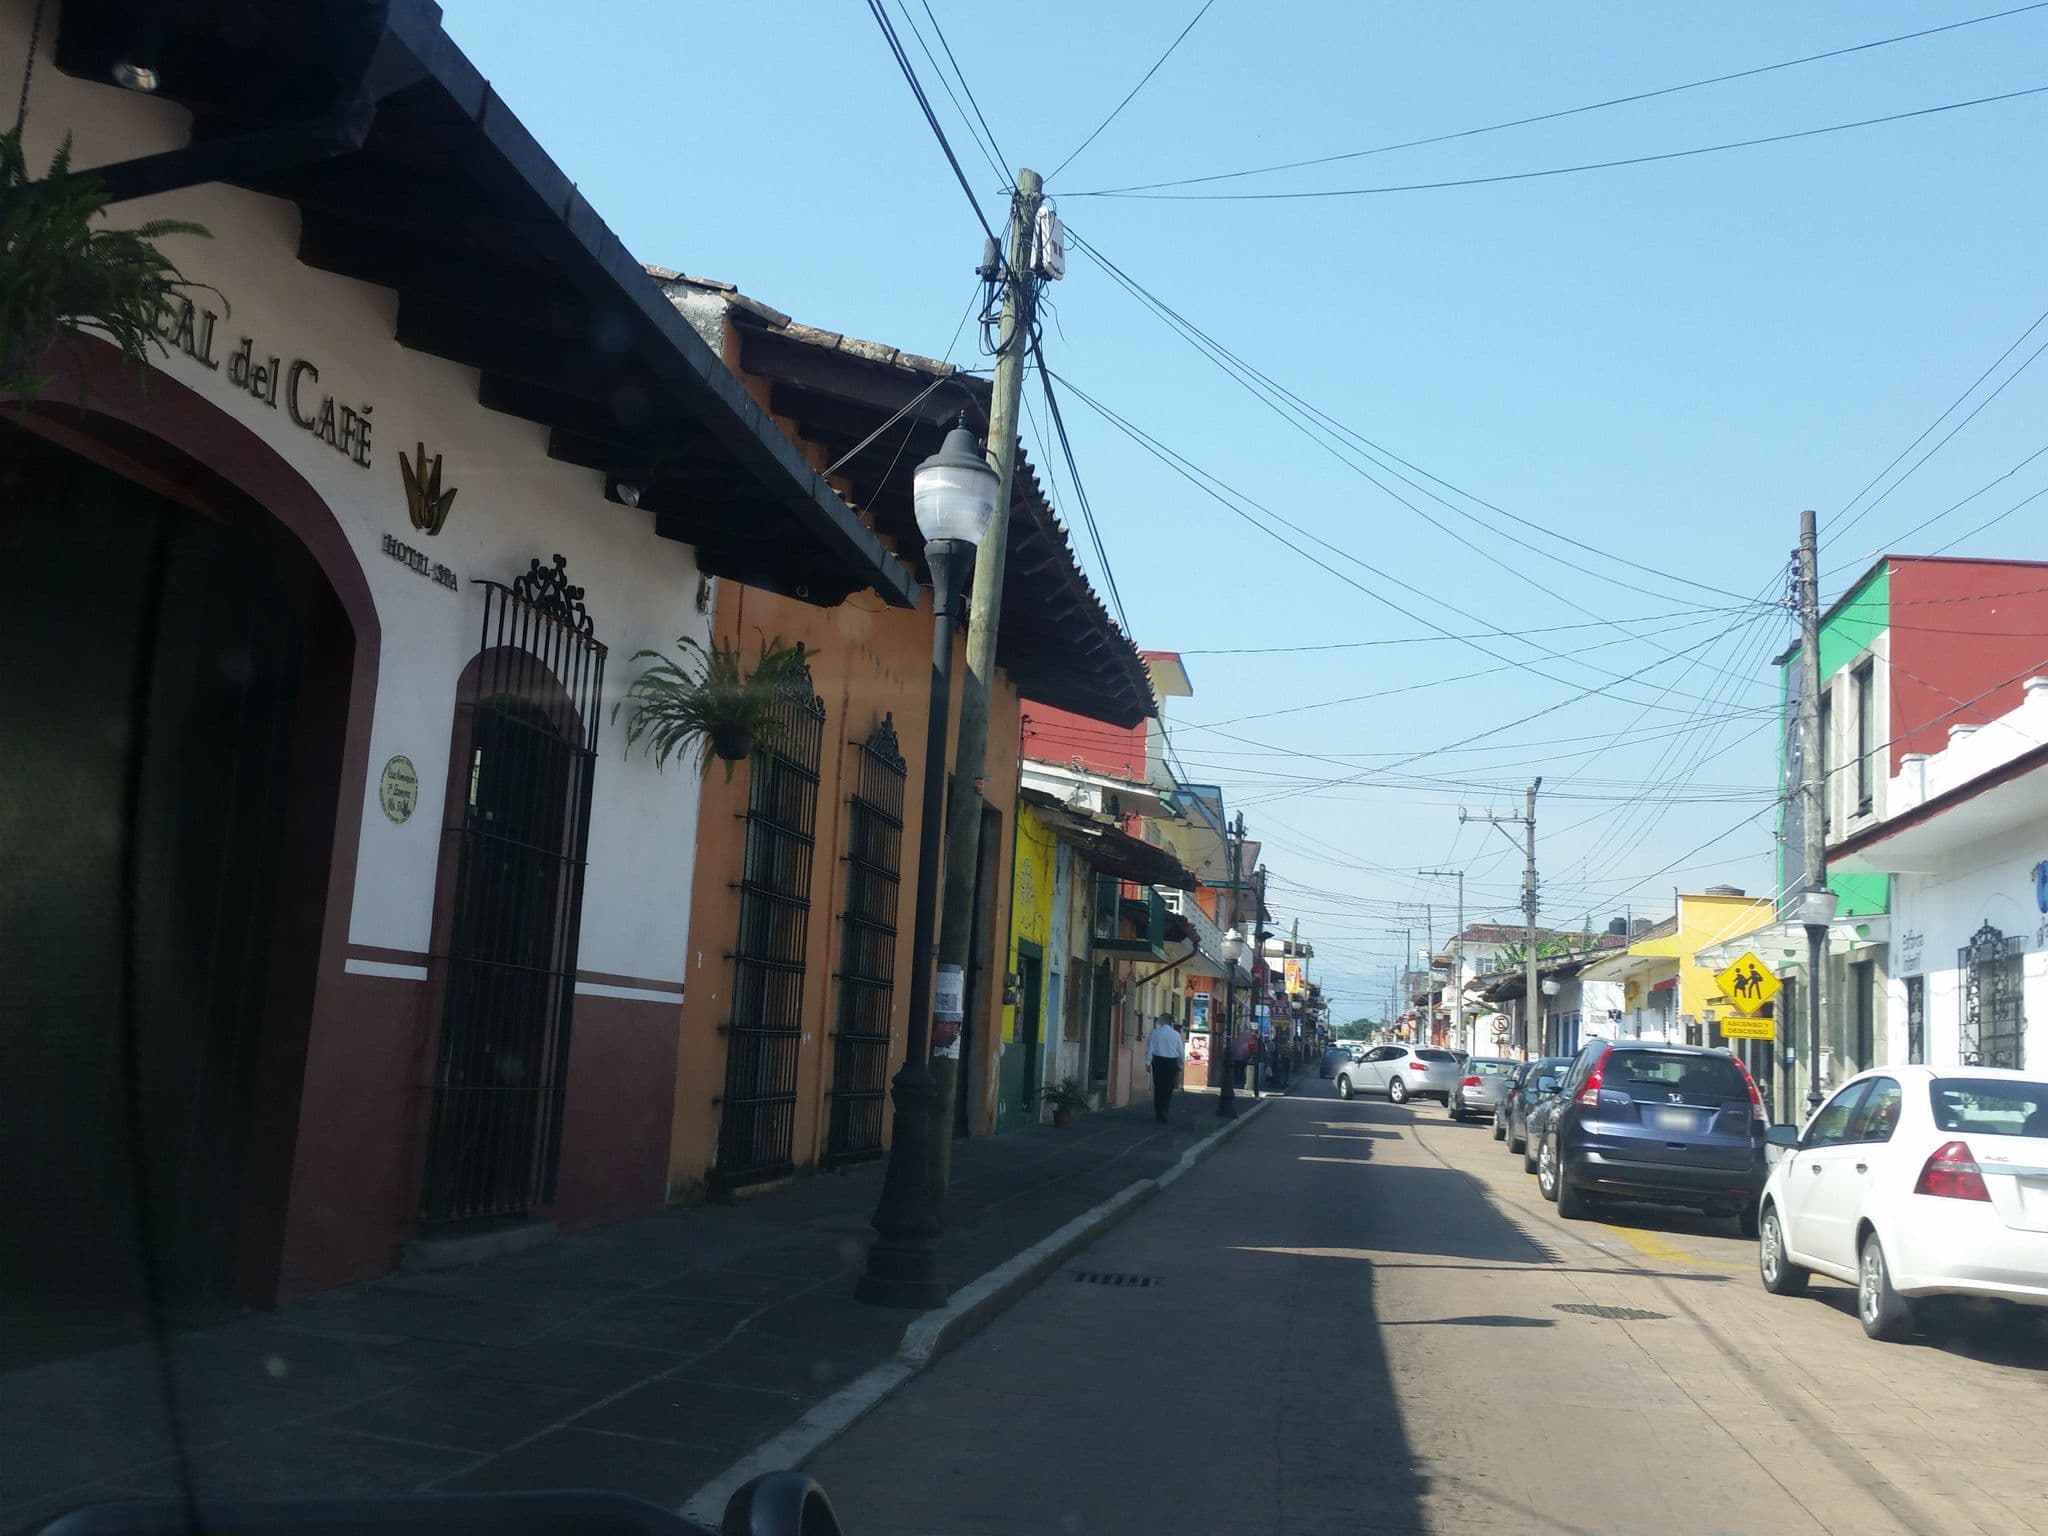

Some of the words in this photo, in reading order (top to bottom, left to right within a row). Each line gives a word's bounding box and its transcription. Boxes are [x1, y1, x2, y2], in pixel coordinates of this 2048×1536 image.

[231, 338, 280, 409] del
[289, 360, 373, 470] CAFÉ
[1727, 1021, 1763, 1029] ASCENSO
[1727, 1028, 1769, 1036] DESCENSO
